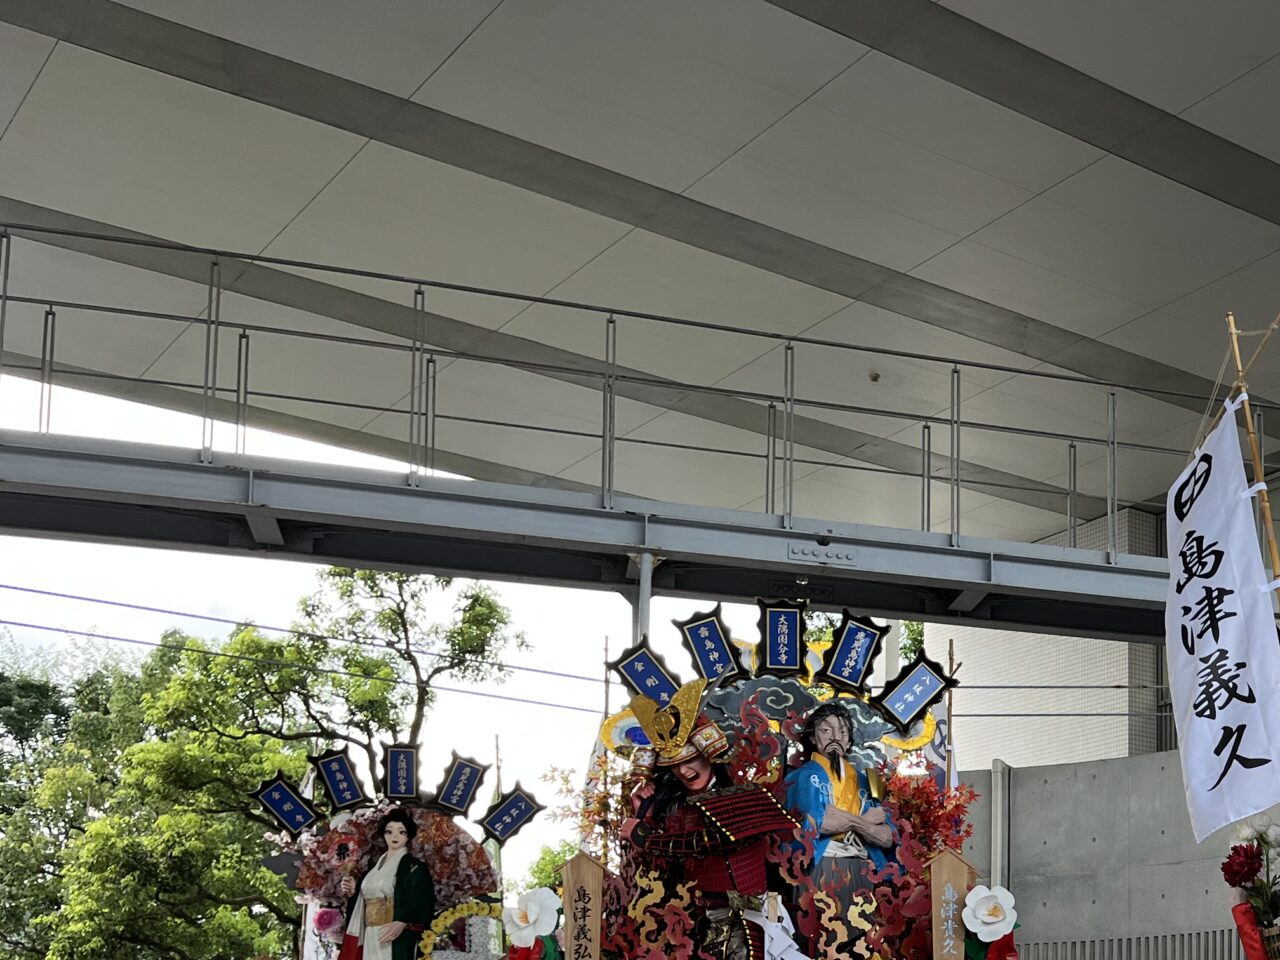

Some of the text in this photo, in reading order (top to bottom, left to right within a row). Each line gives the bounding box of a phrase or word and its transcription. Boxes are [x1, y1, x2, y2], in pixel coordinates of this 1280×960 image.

[777, 614, 789, 664] 大隅国分寺
[1174, 530, 1272, 792] 島津義久
[894, 674, 933, 714] 八坂神社
[572, 885, 593, 960] 島津義弘
[940, 883, 959, 955] 島津貴久
